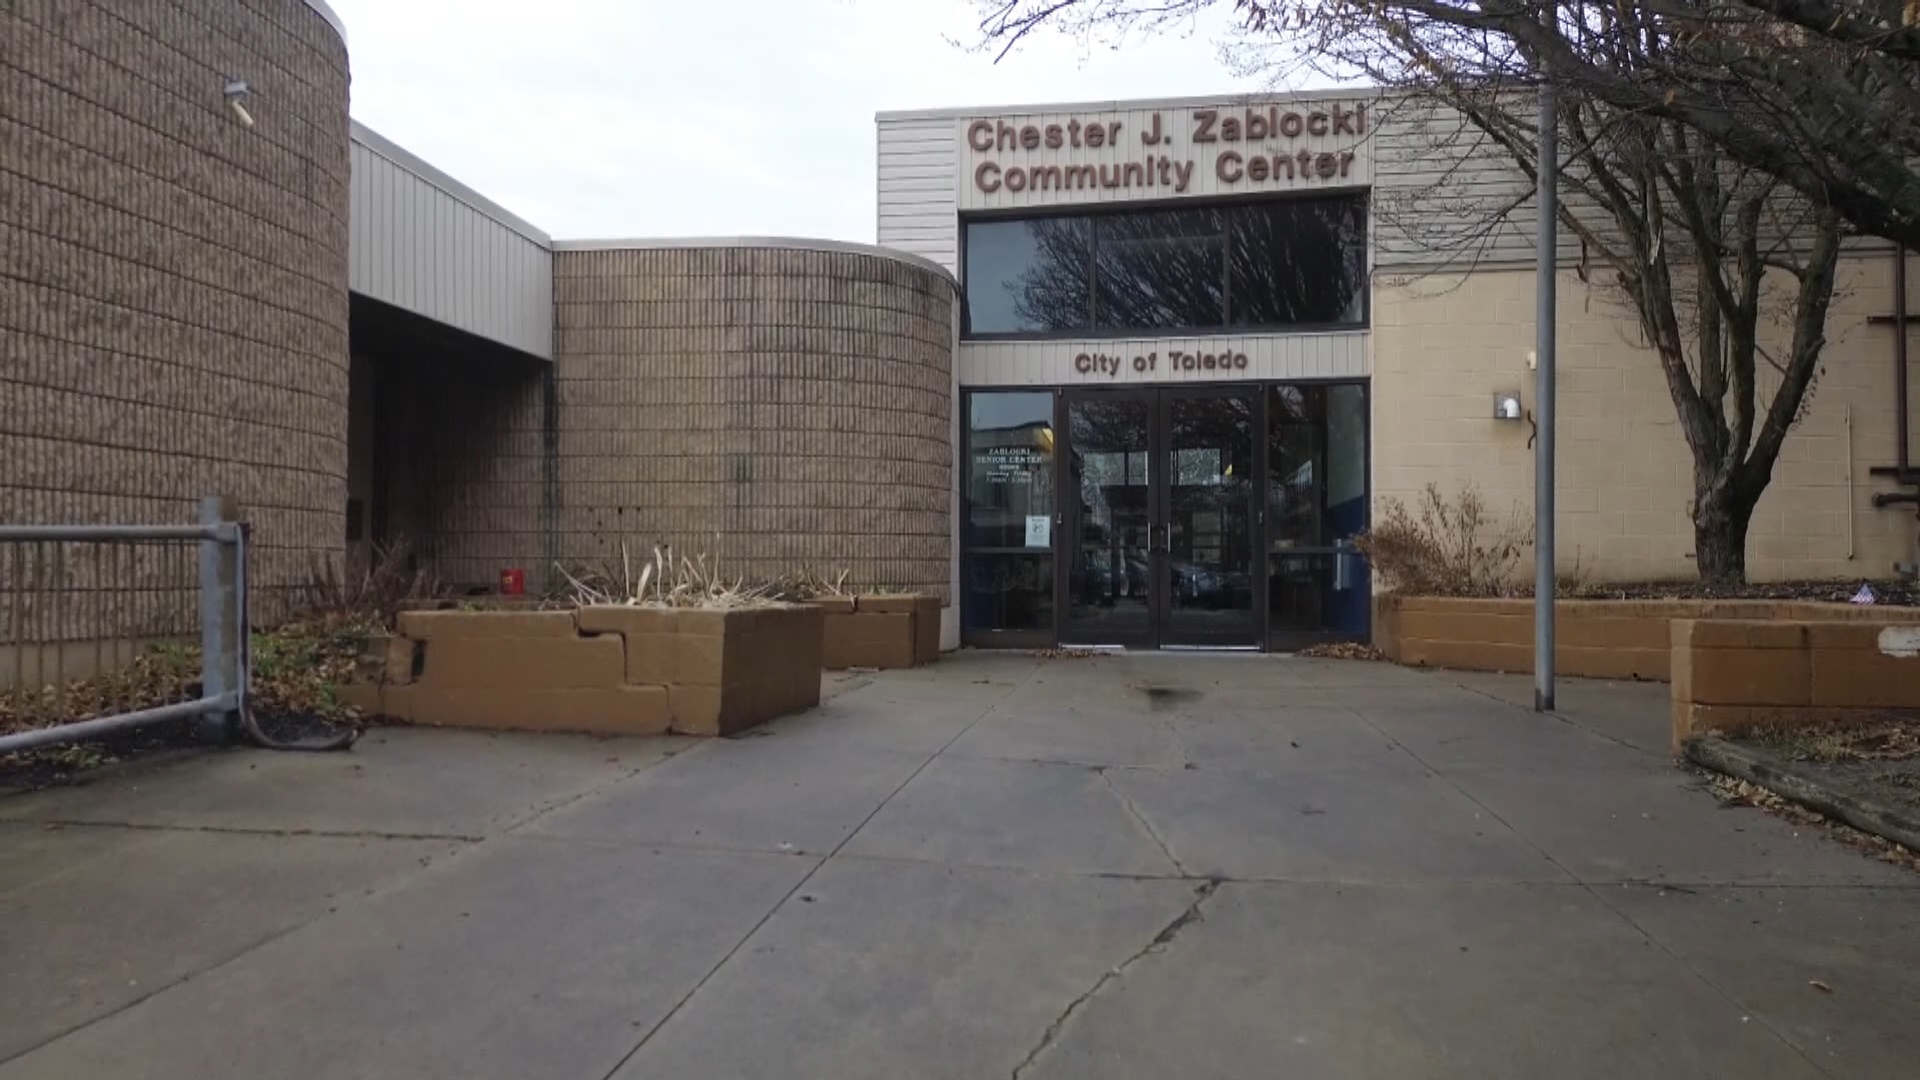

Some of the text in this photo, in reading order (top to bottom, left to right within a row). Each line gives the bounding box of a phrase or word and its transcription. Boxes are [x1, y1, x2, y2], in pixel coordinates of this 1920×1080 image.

[968, 102, 1365, 151] Chester J. Zablocki
[975, 148, 1355, 193] Community Center
[1075, 349, 1248, 377] City of Toledo
